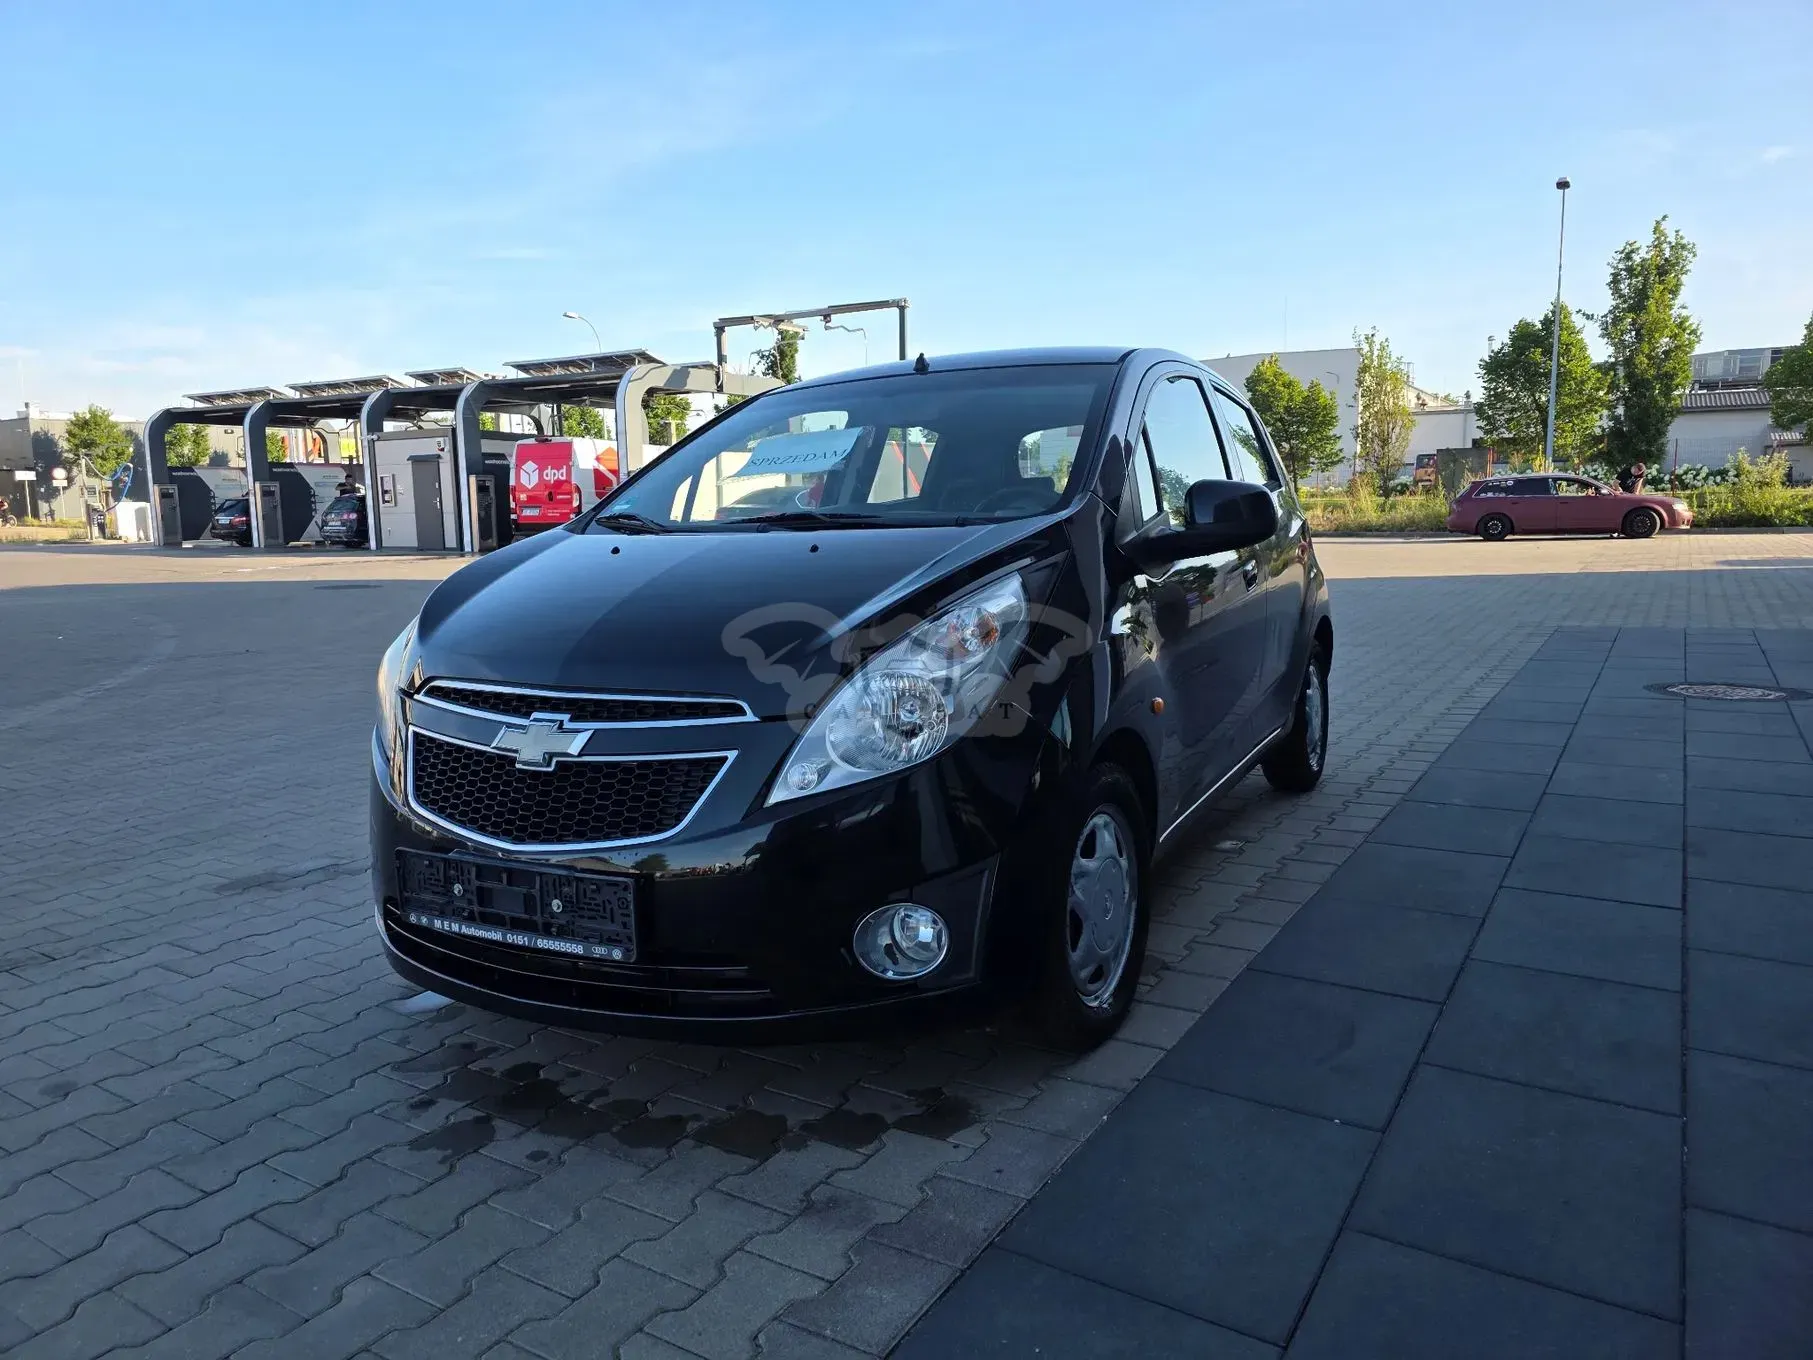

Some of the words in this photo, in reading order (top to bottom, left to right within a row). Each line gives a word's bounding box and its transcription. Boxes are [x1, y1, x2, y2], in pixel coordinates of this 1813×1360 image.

[751, 449, 848, 466] SPRZEDAM
[543, 465, 567, 484] dpd
[434, 919, 442, 929] M
[443, 920, 450, 930] E
[451, 922, 459, 932] M
[461, 925, 503, 941] Automobil
[506, 933, 528, 946] 0151
